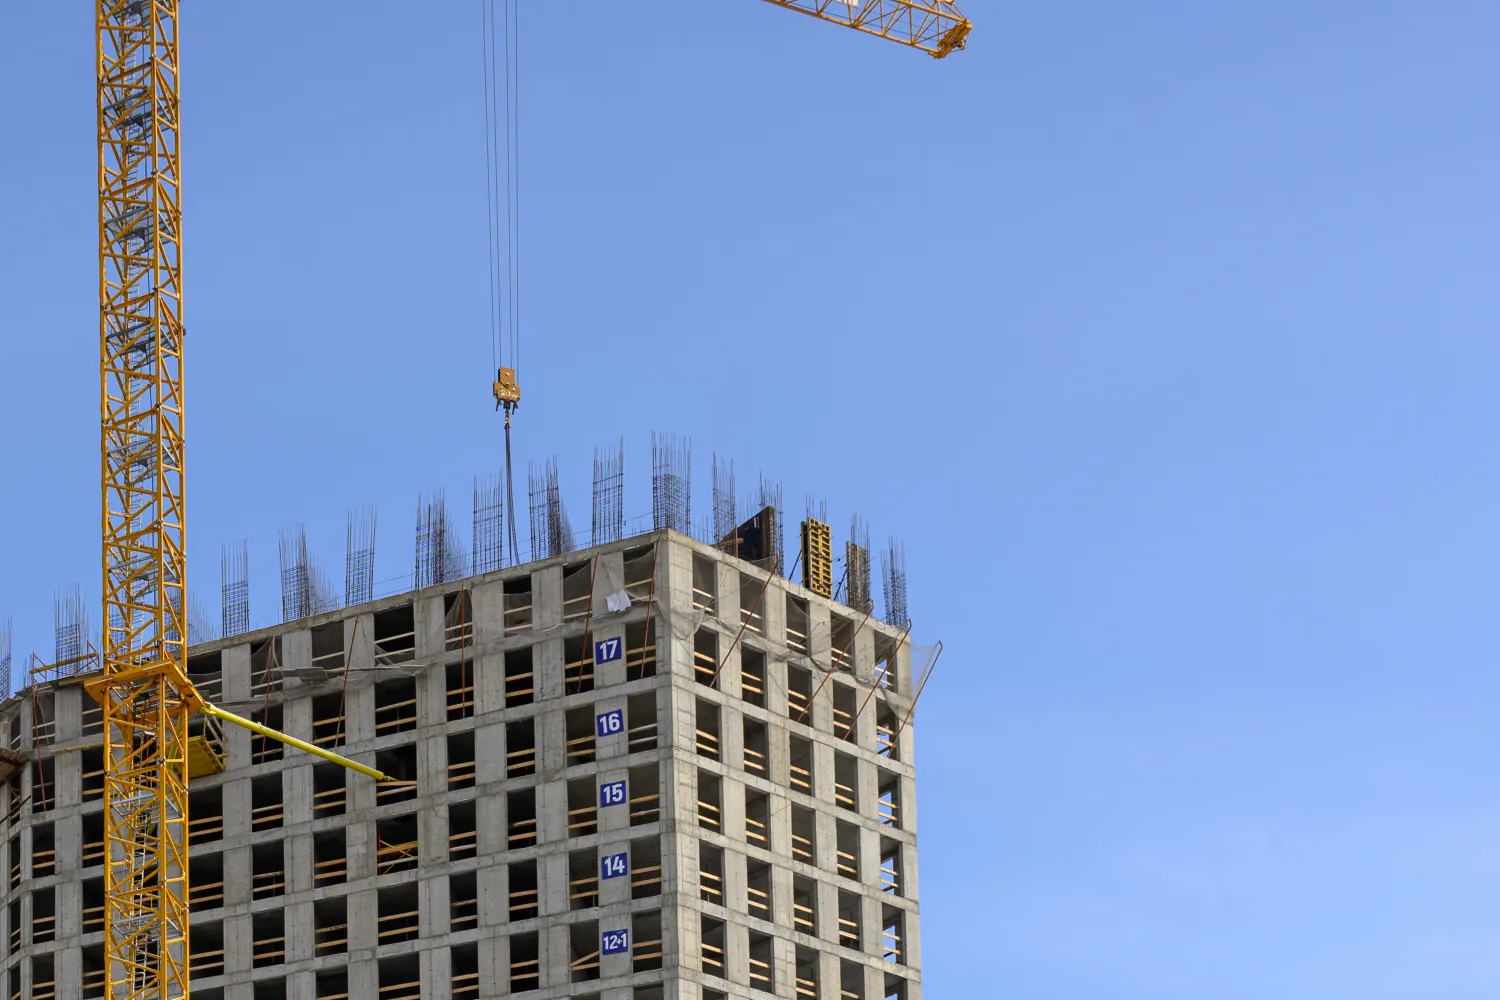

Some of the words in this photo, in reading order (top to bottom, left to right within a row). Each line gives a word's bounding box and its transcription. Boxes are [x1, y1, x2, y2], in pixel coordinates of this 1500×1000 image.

[600, 640, 618, 659] 17
[600, 714, 619, 733] 16
[604, 784, 622, 803] 15
[605, 856, 624, 875] 14
[604, 933, 627, 950] 12+1
